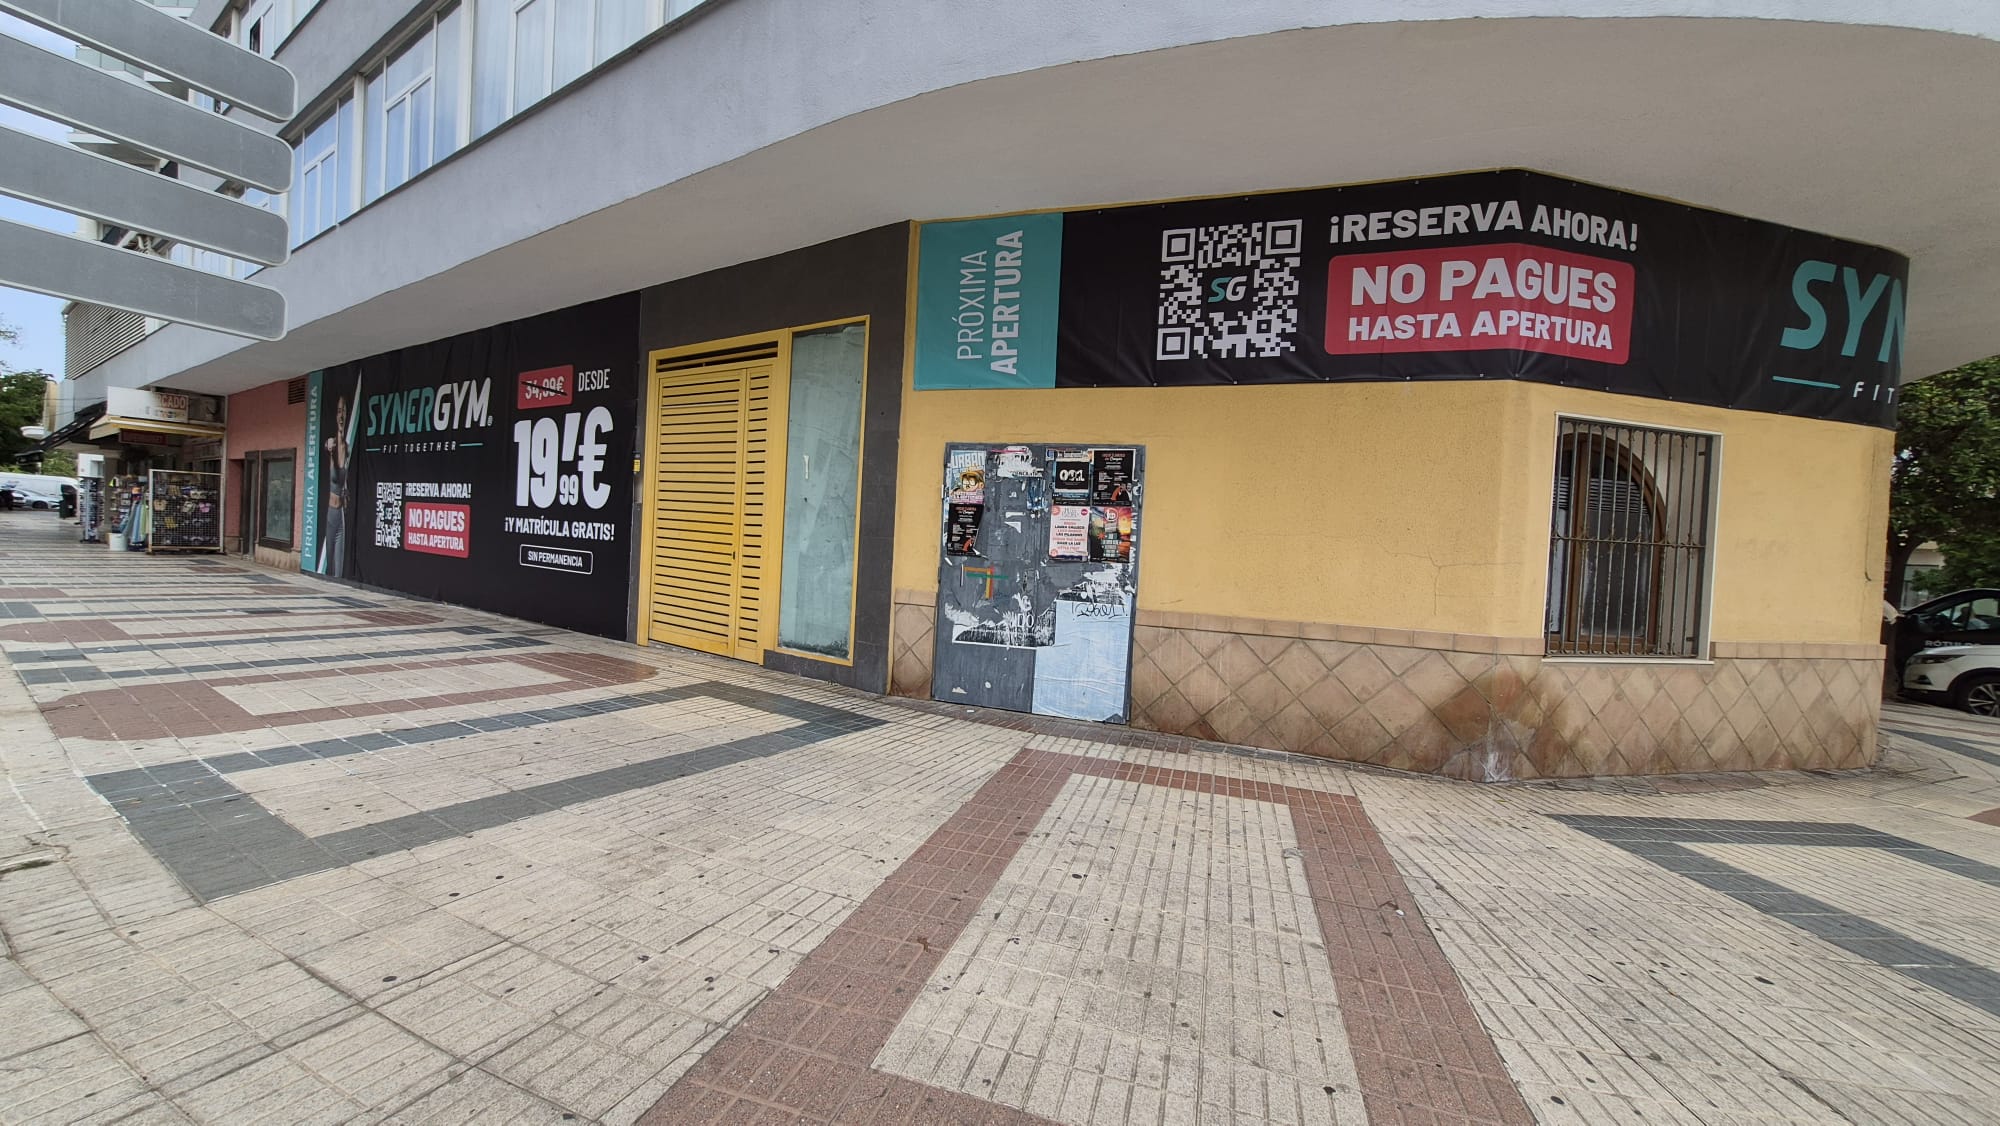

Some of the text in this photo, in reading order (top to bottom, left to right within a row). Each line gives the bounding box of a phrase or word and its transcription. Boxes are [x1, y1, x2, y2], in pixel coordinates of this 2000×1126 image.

[1329, 200, 1638, 252] ¡RESERVA AHORA!
[1207, 275, 1248, 303] SG
[1351, 257, 1617, 313] NO PAGUES
[952, 250, 987, 360] PRÓXIMA
[990, 230, 1024, 375] APERTURA
[1348, 309, 1613, 350] HASTA APERTURA
[578, 368, 611, 392] DESDE
[305, 385, 318, 480] APERTURA
[383, 440, 457, 454] FIT TOGETHER
[405, 483, 472, 499] ¡RESERVA AHORA!
[408, 508, 465, 533] NO PAGUES
[504, 515, 616, 542] ¡Y MATRÍCULA GRATIS!
[408, 532, 465, 551] HASTA APERTURA
[527, 550, 583, 568] SIN PERMANENCIA
